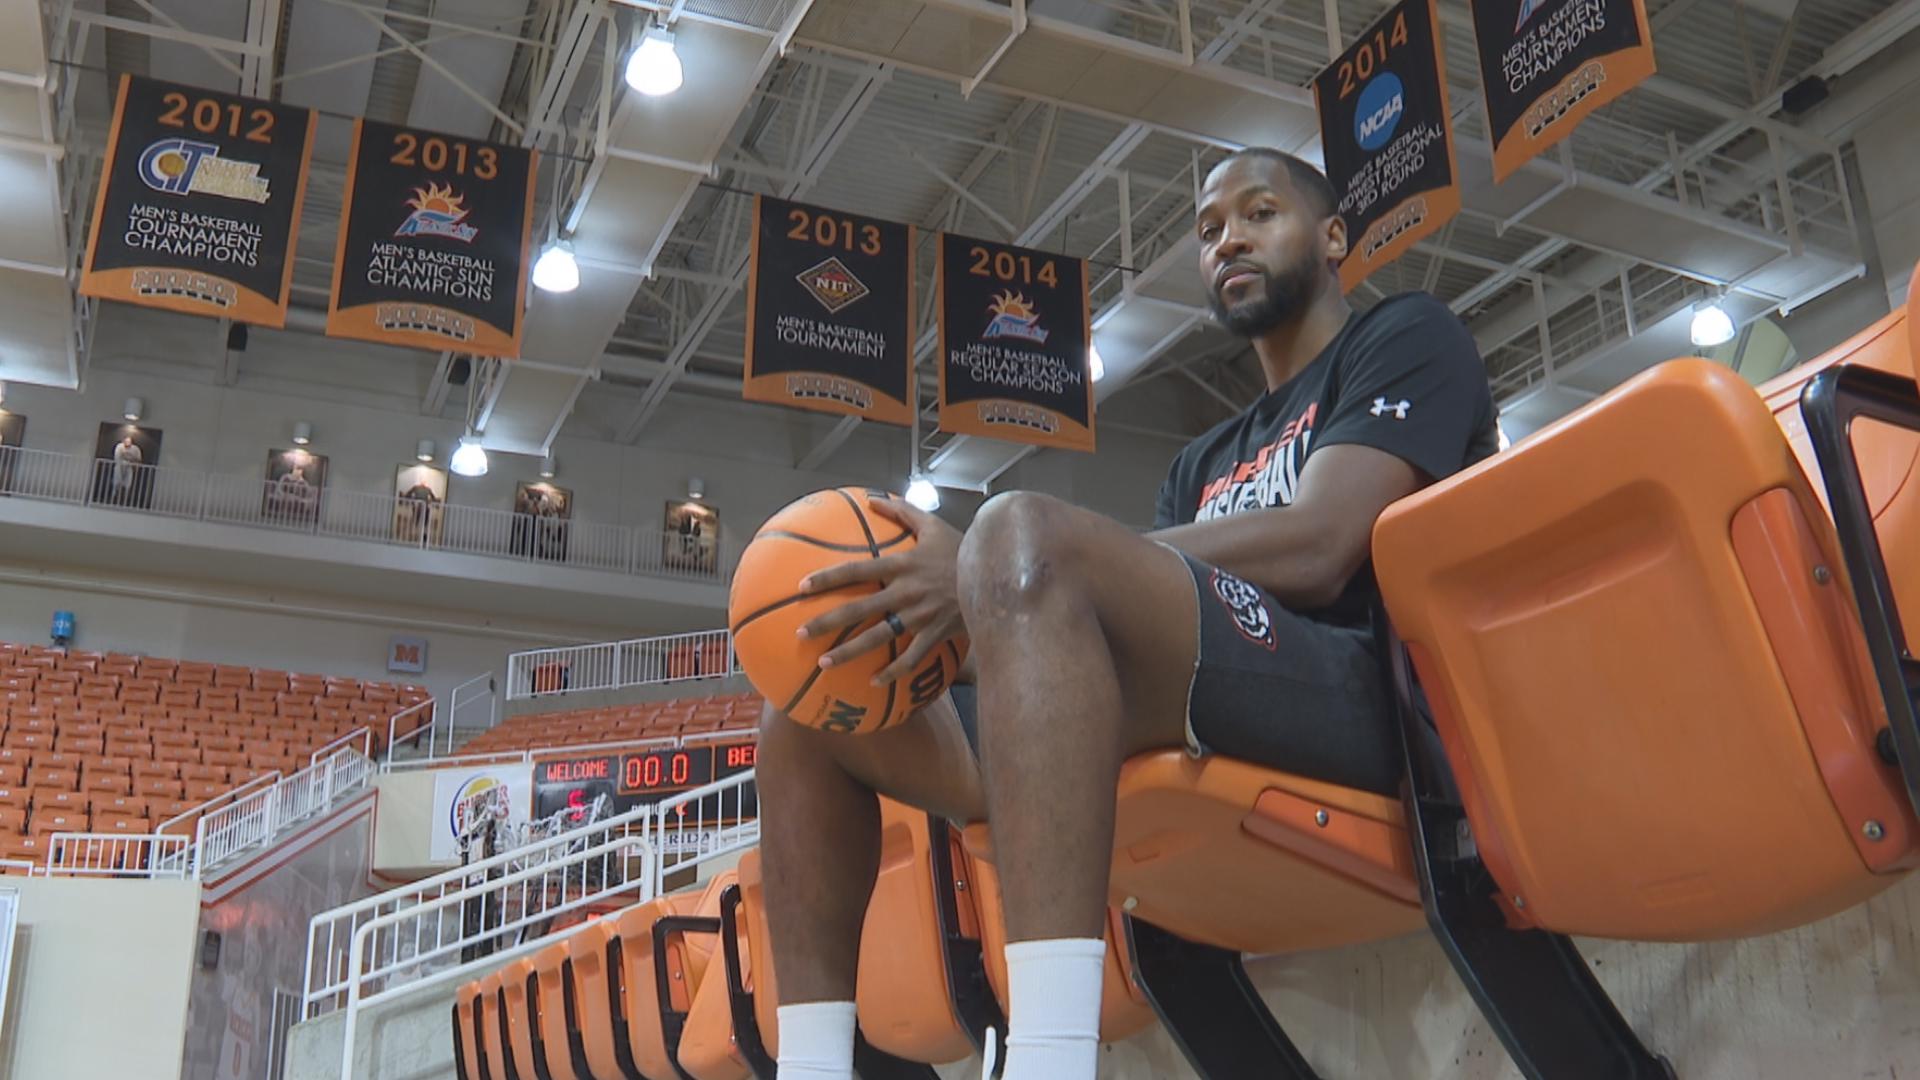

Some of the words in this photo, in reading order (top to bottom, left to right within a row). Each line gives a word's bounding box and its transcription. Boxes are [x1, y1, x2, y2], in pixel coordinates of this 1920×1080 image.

[1338, 11, 1409, 99] 2014
[1502, 30, 1536, 66] MEN'S
[1509, 13, 1606, 93] CHAMPIONS
[158, 92, 275, 144] 2012
[1359, 92, 1403, 142] NCAA
[390, 133, 498, 181] 2013
[1347, 160, 1374, 191] MEN'S
[1375, 121, 1427, 168] BASKETBALL
[1383, 123, 1444, 179] REGIONAL
[1381, 154, 1425, 198] ROUND
[129, 215, 262, 251] TOURNAMENT
[131, 203, 178, 222] MEN'S
[181, 212, 263, 237] BASKETBALL
[787, 209, 882, 256] 2013
[124, 231, 258, 267] CHAMPIONS
[371, 242, 415, 259] MEN'S
[418, 249, 496, 272] BASKETBALL
[367, 268, 492, 301] CHAMPIONS
[369, 255, 453, 280] ATLANTIC
[458, 267, 493, 287] SUN
[815, 276, 853, 293] NIT
[969, 246, 1059, 289] 2014
[776, 314, 815, 330] MEN'S
[818, 322, 886, 345] BASKETBALL
[776, 325, 886, 360] TOURNAMENT
[951, 351, 1020, 373] REGULAR
[1023, 361, 1082, 385] SEASON
[966, 342, 1001, 355] MEN'S
[1004, 348, 1067, 368] BASKETBALL
[970, 367, 1064, 395] CHAMPIONS
[394, 643, 420, 665] M
[546, 759, 609, 781] WELCOME
[626, 753, 689, 787] 00.0
